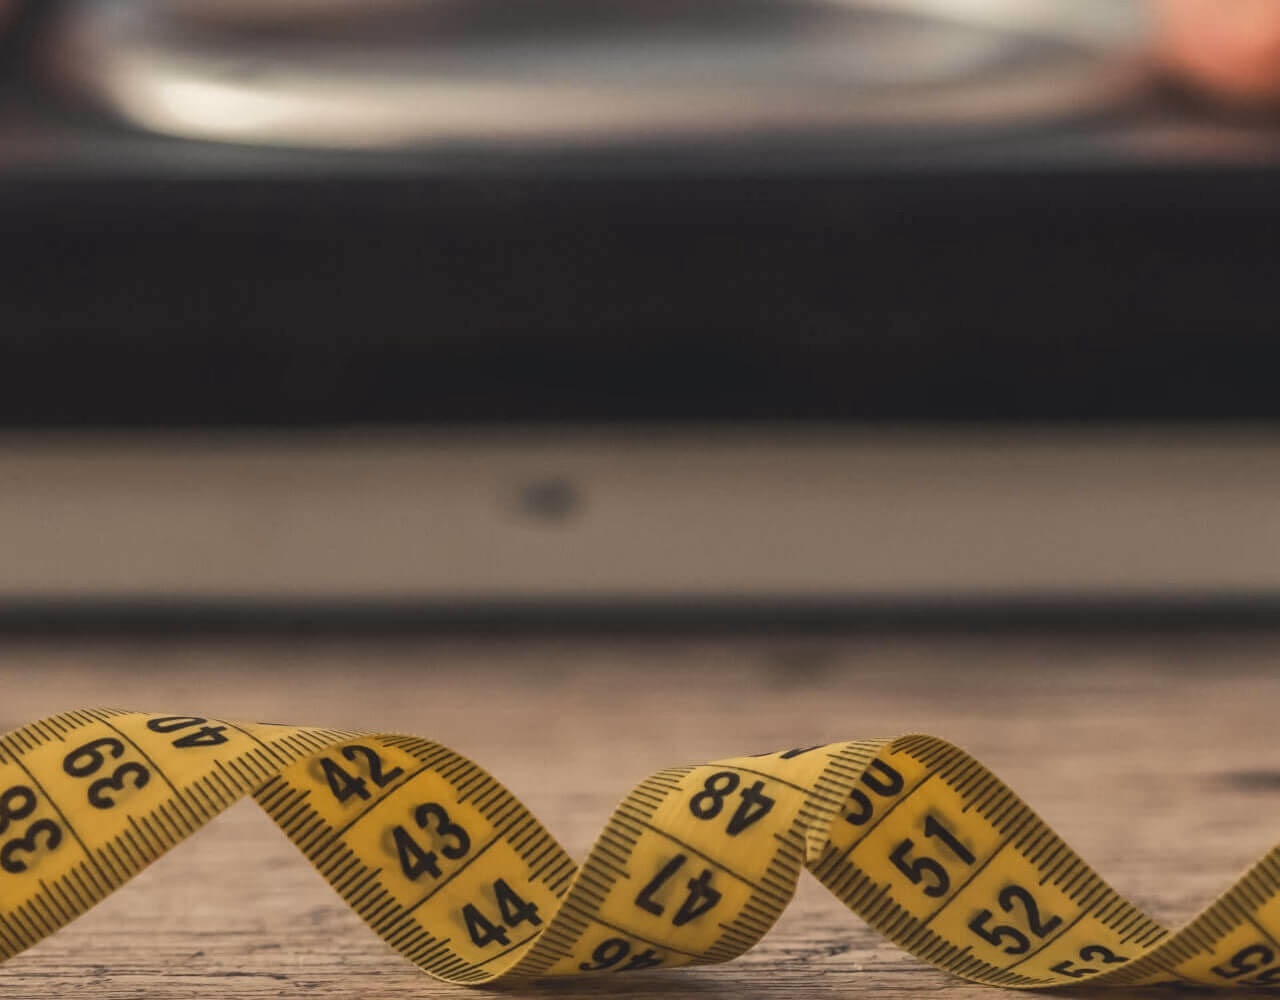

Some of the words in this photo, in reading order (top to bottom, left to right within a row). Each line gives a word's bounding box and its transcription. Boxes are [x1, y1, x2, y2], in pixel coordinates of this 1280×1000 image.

[147, 716, 229, 748] 40
[63, 738, 149, 809] 39
[319, 745, 404, 803] 42
[690, 772, 774, 836] 48
[392, 802, 471, 881] 43
[889, 814, 976, 898] 51
[462, 879, 542, 948] 44
[635, 854, 721, 927] 47
[968, 885, 1063, 955] 52
[579, 938, 663, 972] 46
